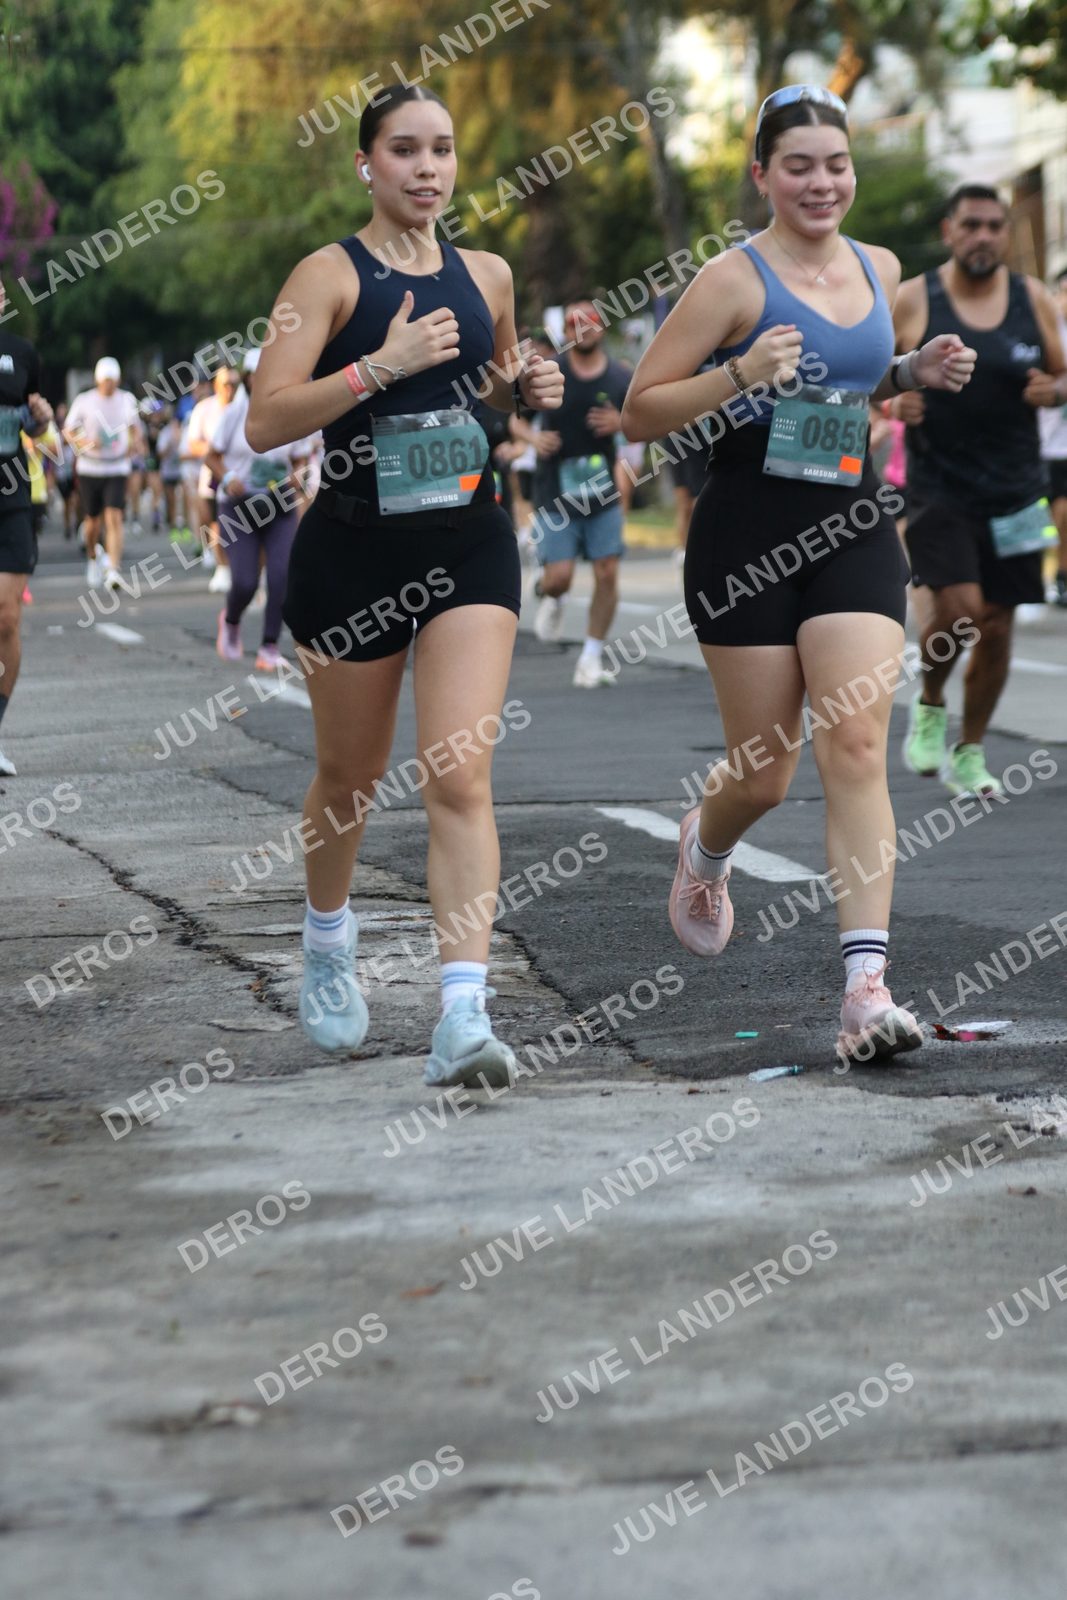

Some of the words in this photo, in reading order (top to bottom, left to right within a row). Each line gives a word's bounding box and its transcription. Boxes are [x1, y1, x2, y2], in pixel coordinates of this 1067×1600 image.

[407, 435, 483, 480] 0861
[803, 468, 838, 479] SAMSUNG
[421, 493, 459, 505] SAMSUNG
